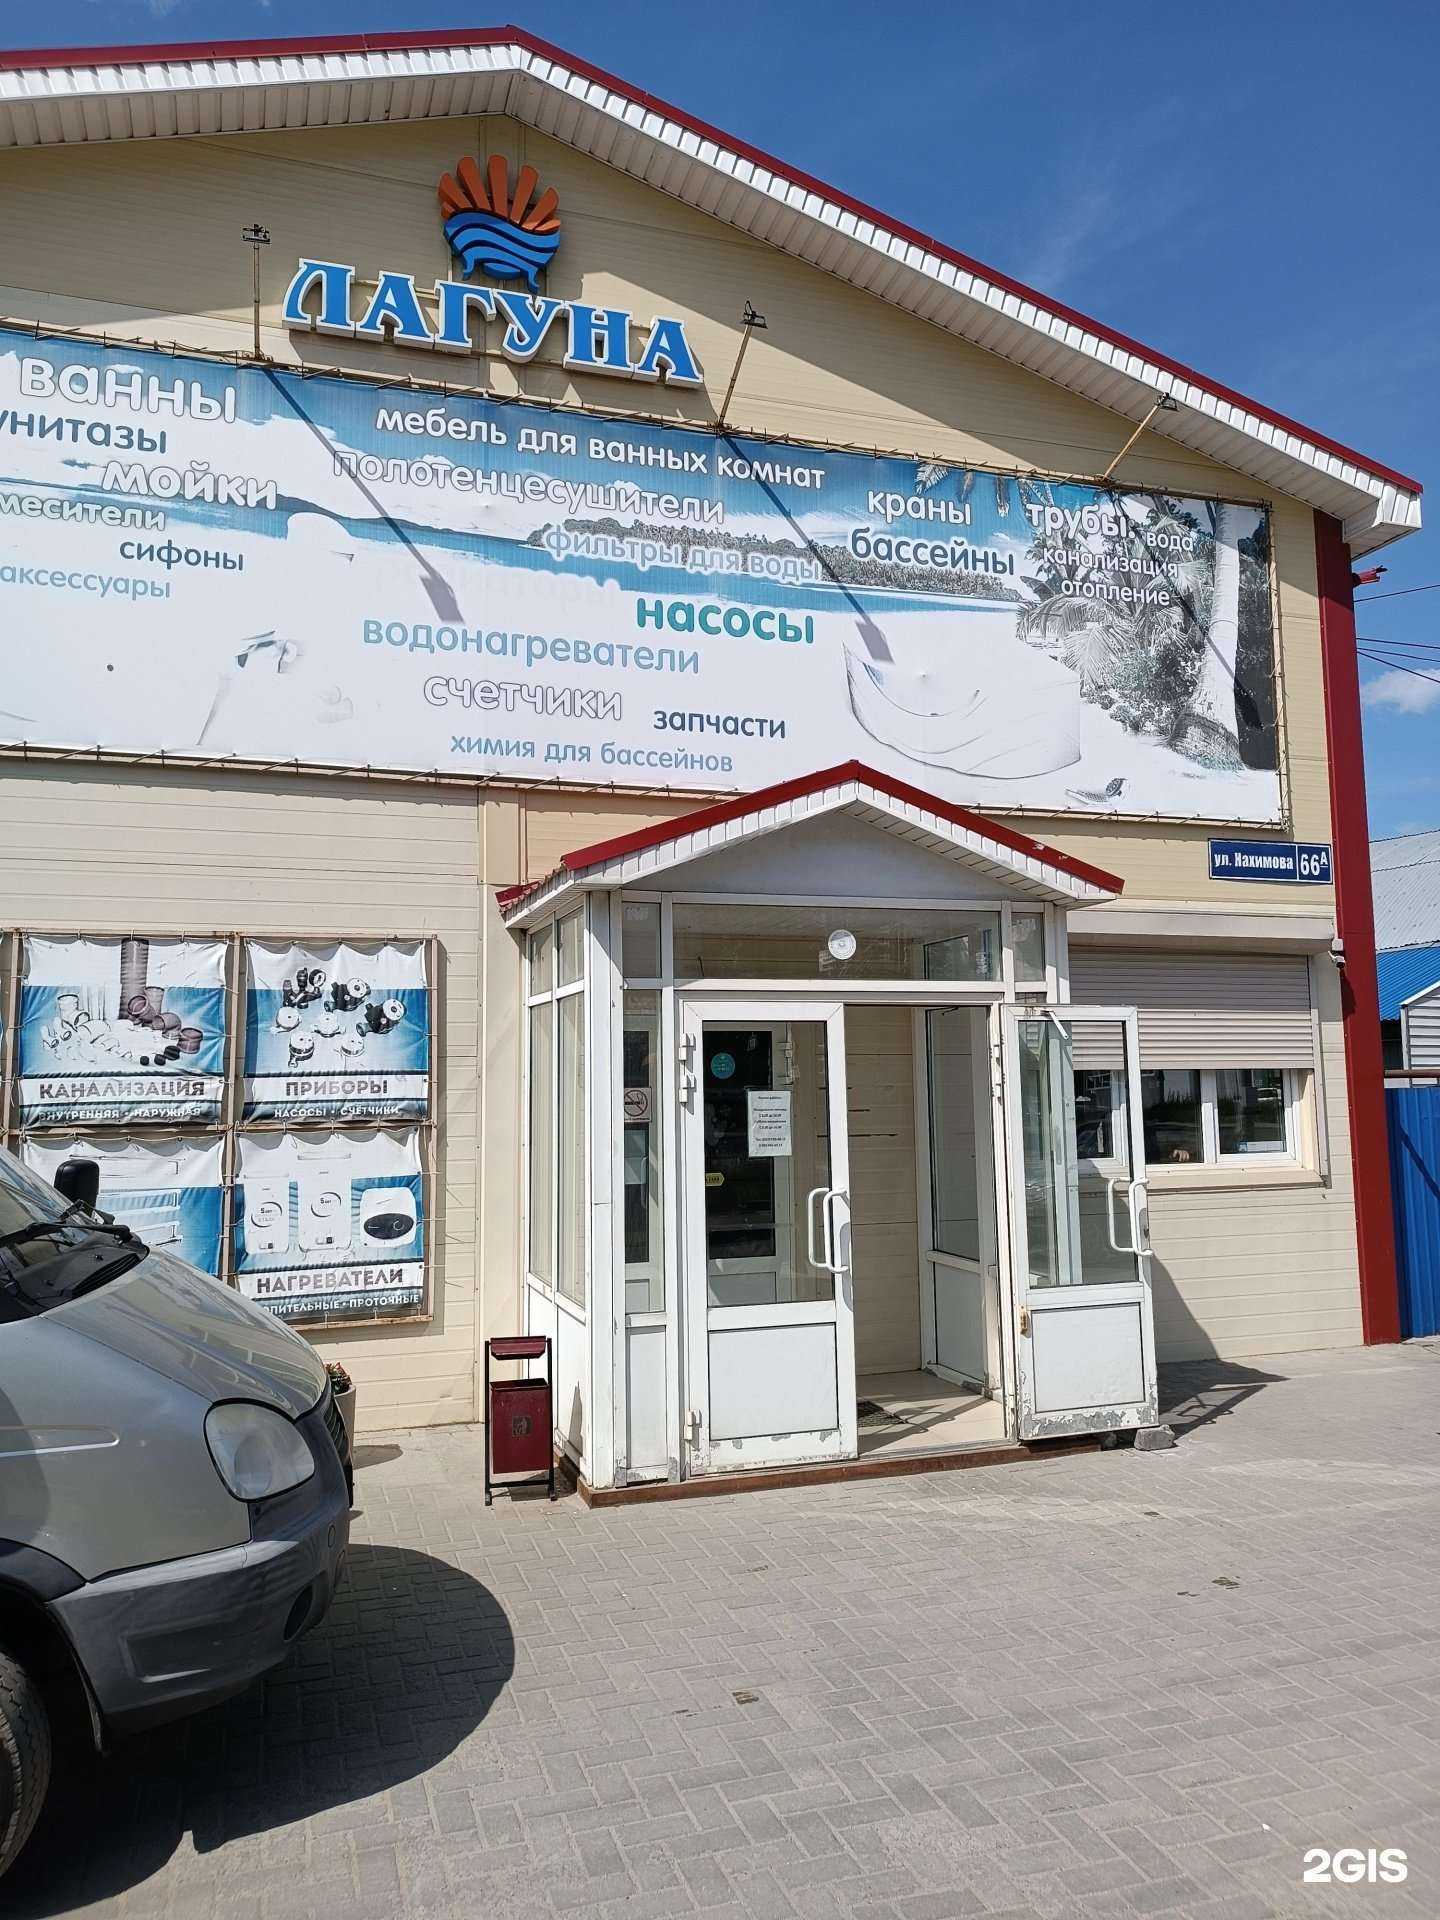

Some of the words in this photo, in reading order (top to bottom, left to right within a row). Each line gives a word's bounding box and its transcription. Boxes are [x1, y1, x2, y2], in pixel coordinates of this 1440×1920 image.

[282, 258, 703, 388] ЛАГУНА
[19, 357, 236, 423] ванны
[376, 407, 507, 446] мебель
[517, 424, 577, 457] для
[589, 439, 708, 475] ванных
[717, 456, 826, 490] комнат
[101, 460, 278, 510] мойки
[333, 451, 725, 525] полотенцесушители
[0, 492, 166, 531] месители
[867, 490, 972, 525] краны
[1026, 503, 1136, 540] трубы:
[1146, 533, 1194, 551] вода
[119, 540, 244, 571] сифоны
[546, 525, 682, 571] фильтры
[689, 548, 743, 570] для
[751, 558, 820, 580] воды
[851, 527, 1015, 576] бассейны
[1043, 548, 1179, 578] канализация
[0, 565, 171, 600] аксессуары
[1061, 579, 1170, 605] отопление
[636, 597, 814, 644] насосы
[363, 619, 699, 674] водонагреватели
[424, 676, 622, 721] счетчики
[653, 708, 786, 739] запчасти
[450, 734, 536, 759] химия
[544, 740, 592, 763] для
[600, 741, 733, 772] бассейнов
[1214, 853, 1232, 868] ул.
[1234, 852, 1294, 870] Нахимова
[39, 1081, 205, 1099] КАНАЛИЗАЦИЯ
[285, 1080, 388, 1097] ПРИБОРЫ
[274, 1108, 326, 1118] НАСОСЫ
[256, 1268, 403, 1294] НАГРЕВАТЕЛИ
[264, 1300, 340, 1316] ПИТЕЛЬНЫЕ
[350, 1294, 419, 1308] ПРОТОЧНЫЕ
